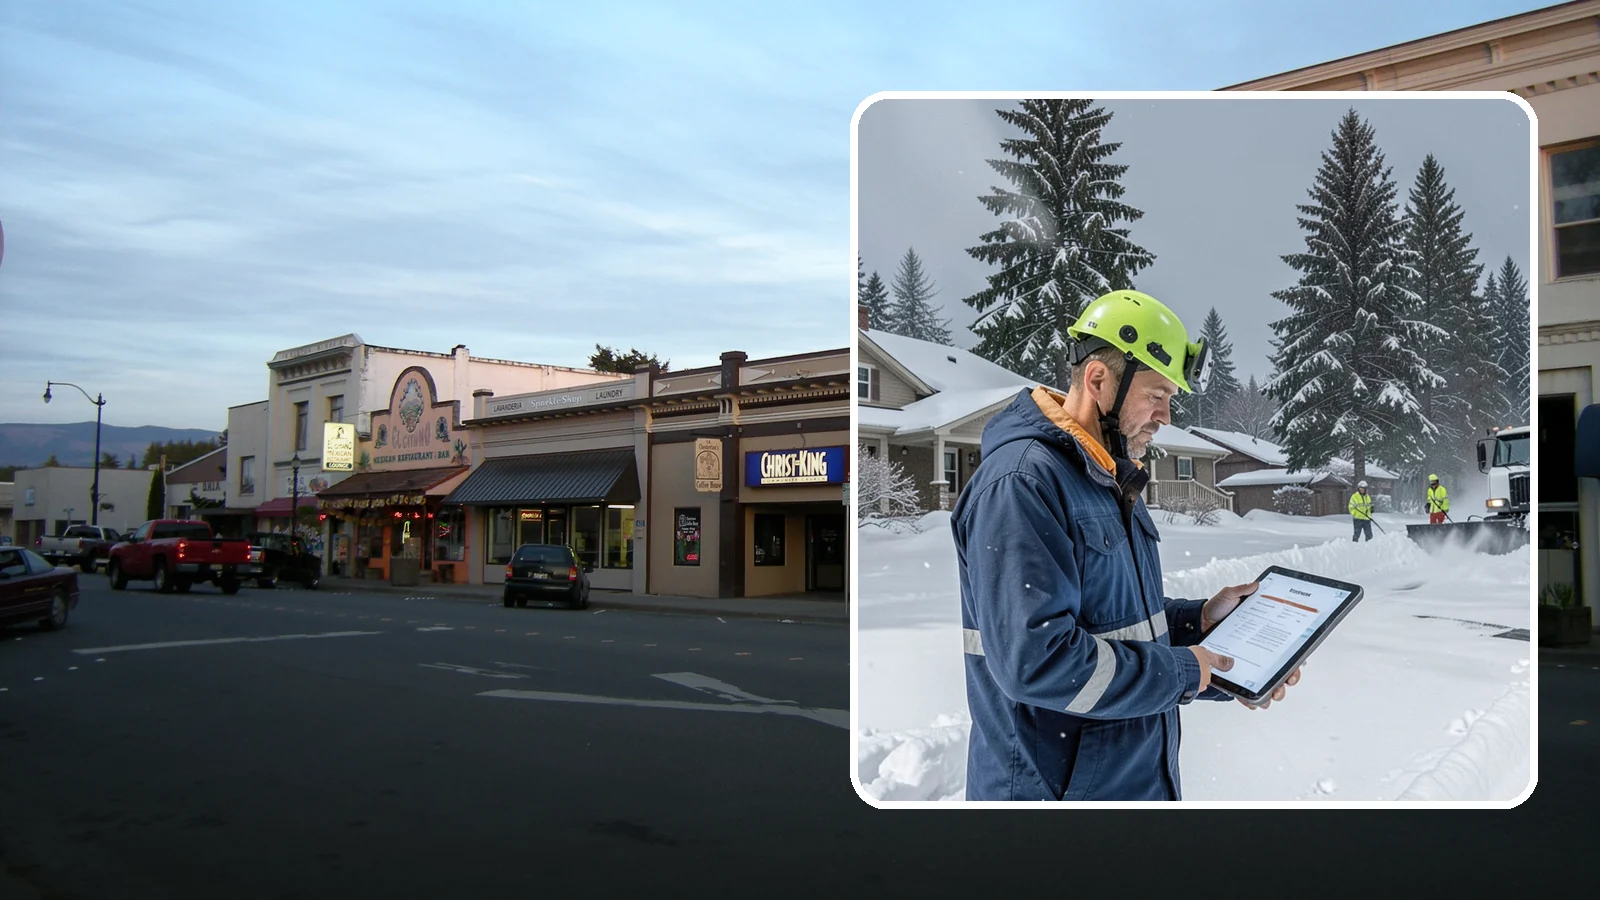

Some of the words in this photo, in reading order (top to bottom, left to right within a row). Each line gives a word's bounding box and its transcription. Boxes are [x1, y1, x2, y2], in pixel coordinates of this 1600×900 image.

[494, 402, 522, 412] LAVANDERIA
[530, 397, 561, 409] Sparkle
[562, 394, 582, 405] Shop
[595, 389, 624, 400] LAUNDRY
[373, 454, 396, 464] MEXICAN
[397, 451, 433, 462] RESTAURANT
[437, 450, 450, 459] BAR
[761, 452, 798, 478] CHRIST
[799, 450, 827, 476] KING
